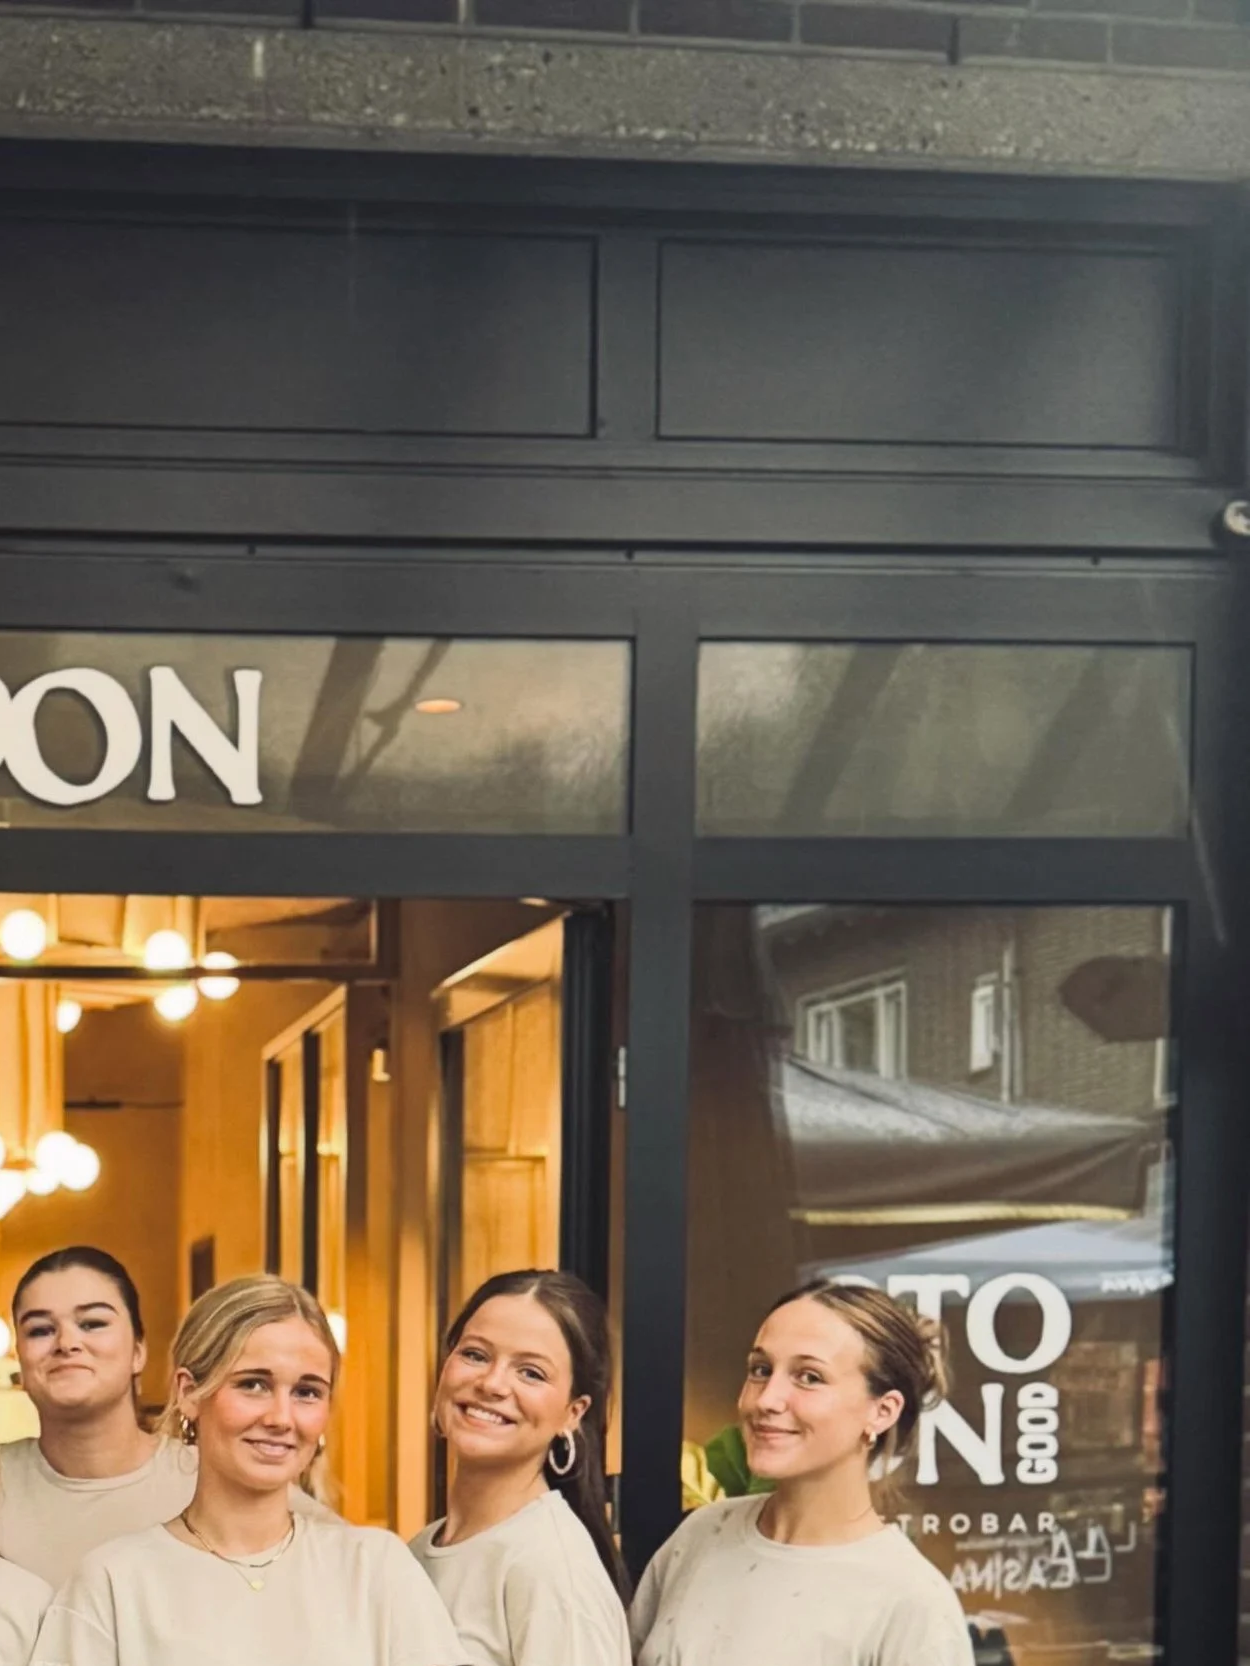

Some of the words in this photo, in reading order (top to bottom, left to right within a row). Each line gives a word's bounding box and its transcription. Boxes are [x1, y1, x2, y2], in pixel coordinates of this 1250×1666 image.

[826, 1272, 1072, 1374] TO
[867, 1382, 1005, 1485] N
[1016, 1381, 1059, 1484] GOOD
[878, 1512, 1057, 1536] TROBAR
